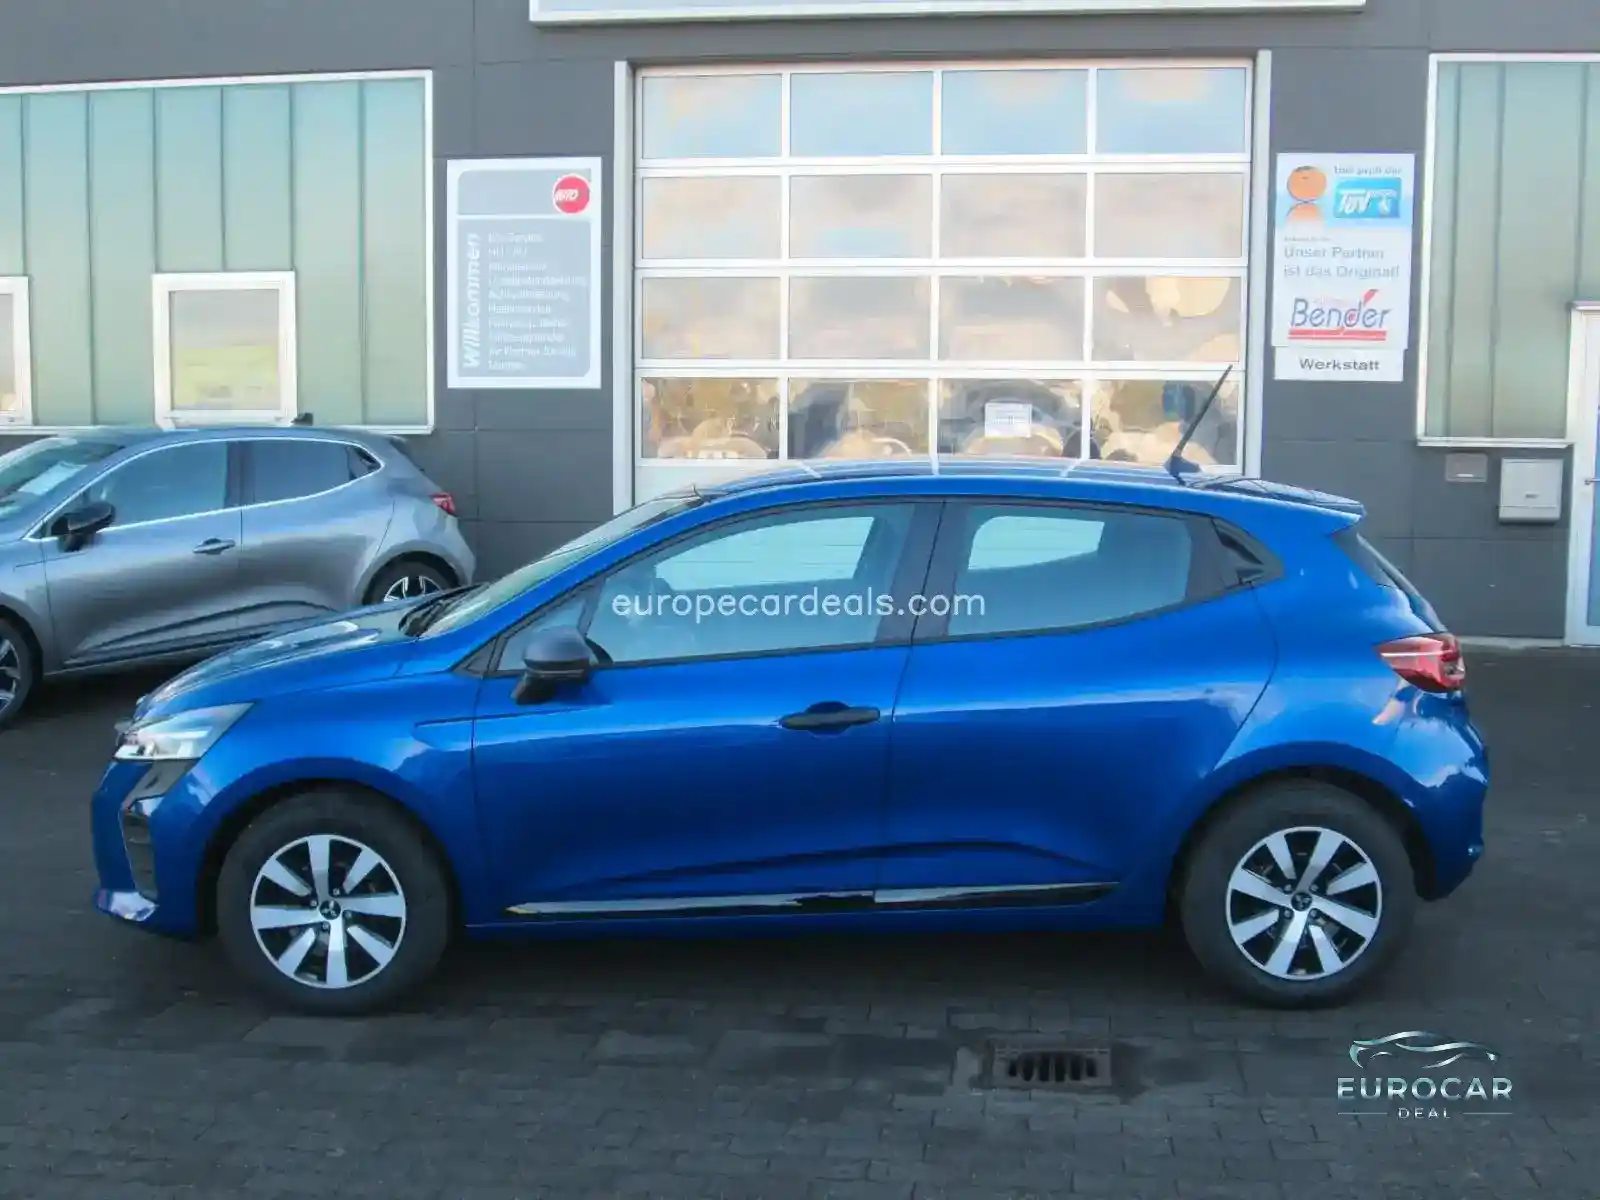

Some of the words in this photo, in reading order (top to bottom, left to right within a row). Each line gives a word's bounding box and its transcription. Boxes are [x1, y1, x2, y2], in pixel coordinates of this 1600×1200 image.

[1284, 246, 1326, 258] Unser
[1284, 264, 1301, 277] ist
[463, 233, 481, 368] Willkommen
[1290, 291, 1392, 329] Bender
[1300, 356, 1380, 371] Werkstatt
